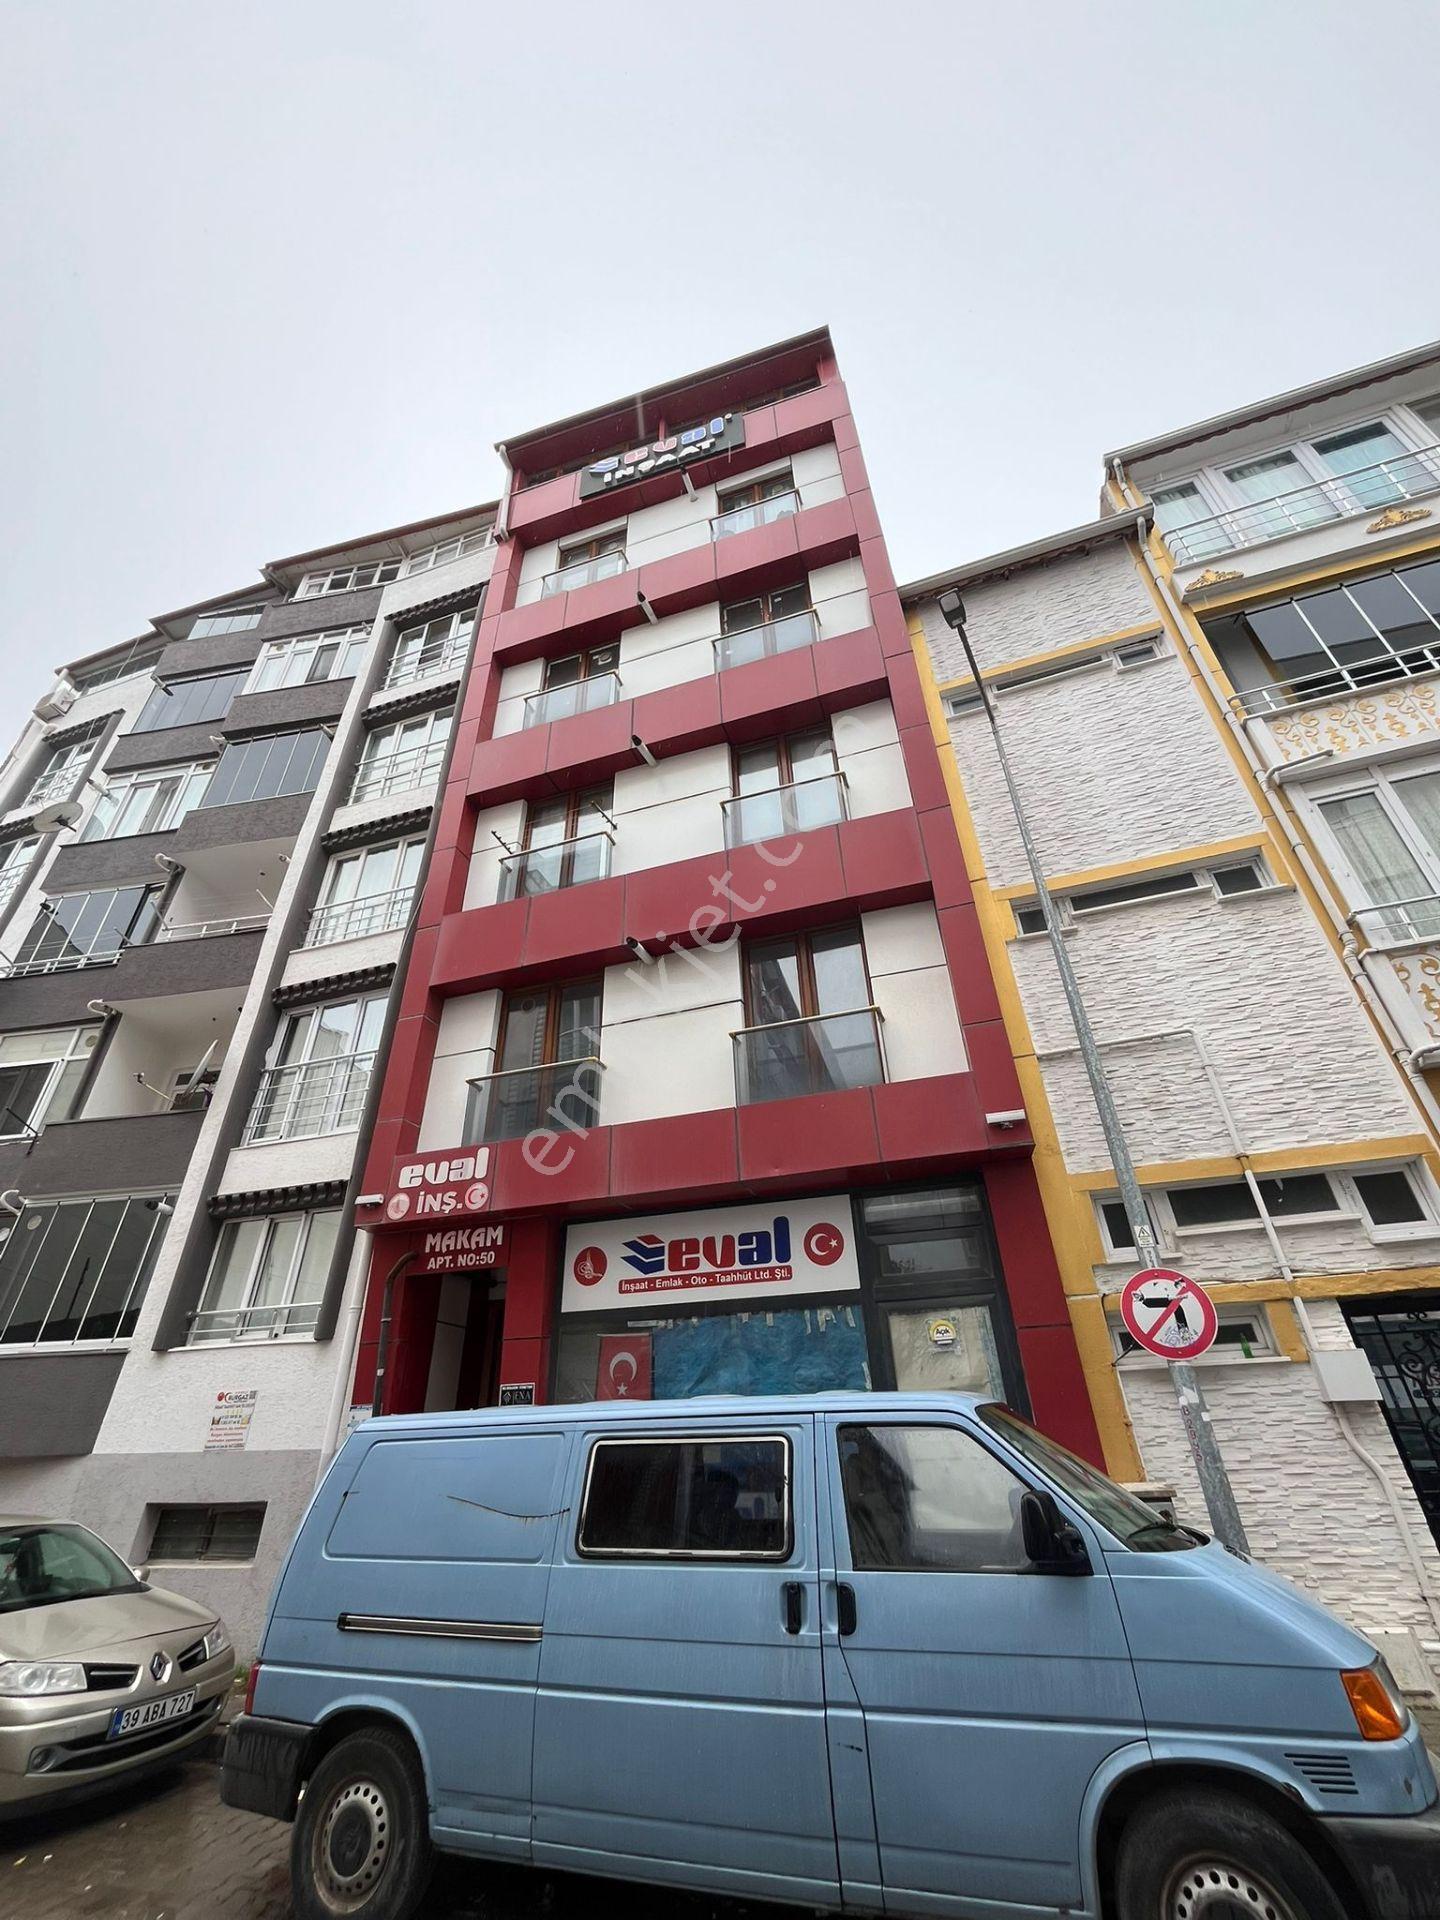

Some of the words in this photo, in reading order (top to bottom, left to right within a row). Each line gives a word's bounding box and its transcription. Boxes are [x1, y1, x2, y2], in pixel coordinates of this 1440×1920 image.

[398, 1147, 490, 1189] eval
[416, 1191, 463, 1214] İNŞ.
[425, 1225, 504, 1253] MAKAM
[668, 1215, 792, 1272] eval
[427, 1256, 454, 1270] APT.
[457, 1251, 495, 1267] NO:50
[621, 1279, 649, 1293] İnşaat
[655, 1278, 683, 1289] Emlak
[690, 1275, 708, 1286] Oto
[715, 1271, 752, 1284] Taahhüt
[754, 1269, 772, 1280] Ltd.
[121, 1709, 140, 1730] 39
[142, 1701, 168, 1724] ABA
[170, 1693, 194, 1716] 727
